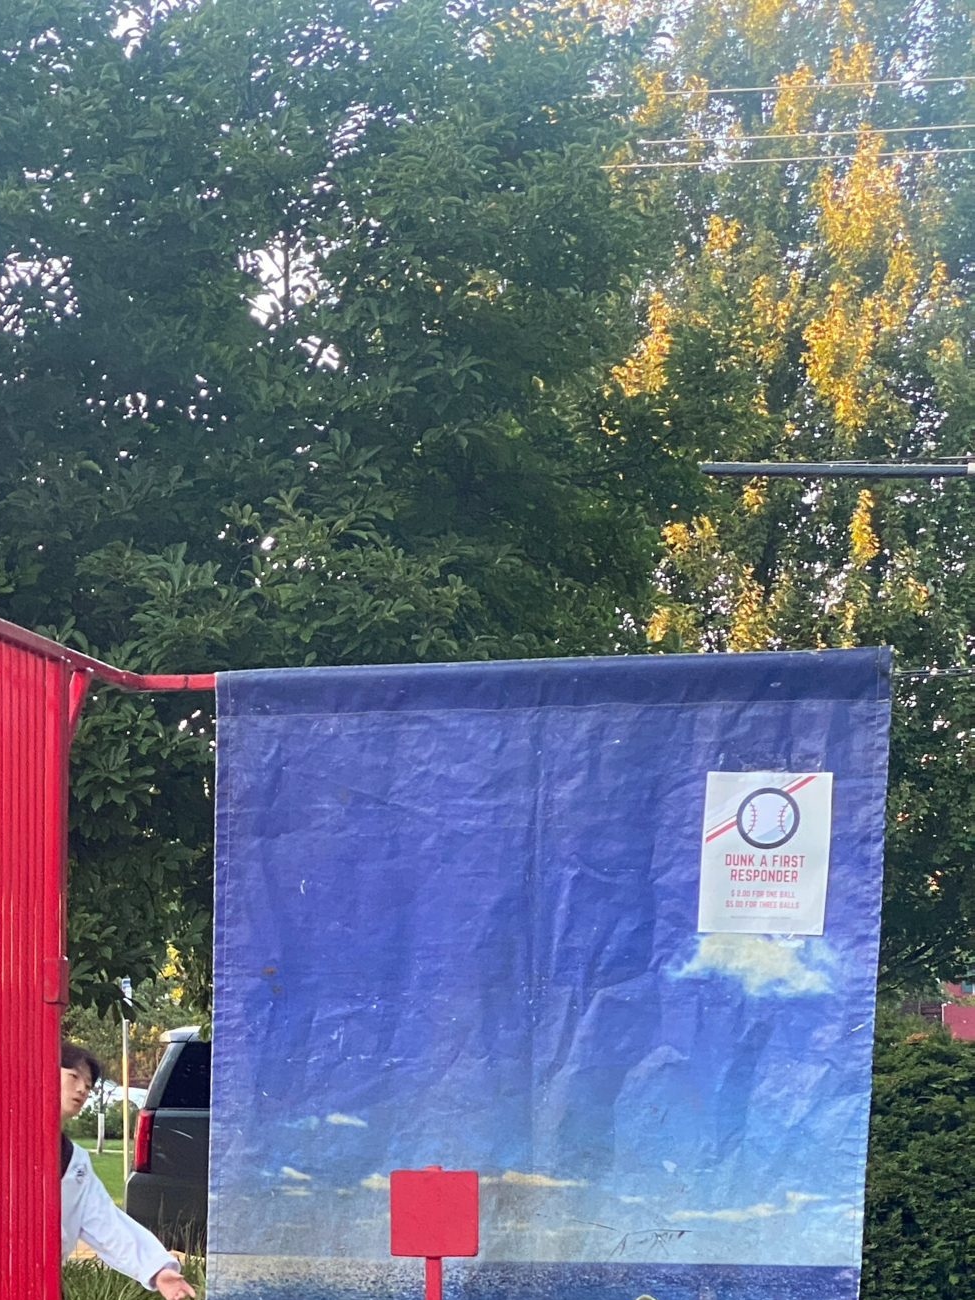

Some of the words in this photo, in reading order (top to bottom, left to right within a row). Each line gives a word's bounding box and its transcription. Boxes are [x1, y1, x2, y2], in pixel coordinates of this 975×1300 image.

[725, 853, 755, 867] DUNK
[759, 854, 768, 867] A
[772, 854, 806, 868] FIRST
[730, 868, 799, 883] RESPONDER
[736, 889, 751, 898] 2.00
[752, 890, 765, 898] FOR
[766, 890, 778, 898] ONE
[779, 890, 796, 899] BALL
[725, 900, 744, 908] $5.00
[745, 900, 757, 908] FOR
[759, 900, 778, 909] THREE
[779, 901, 800, 910] BALLS
